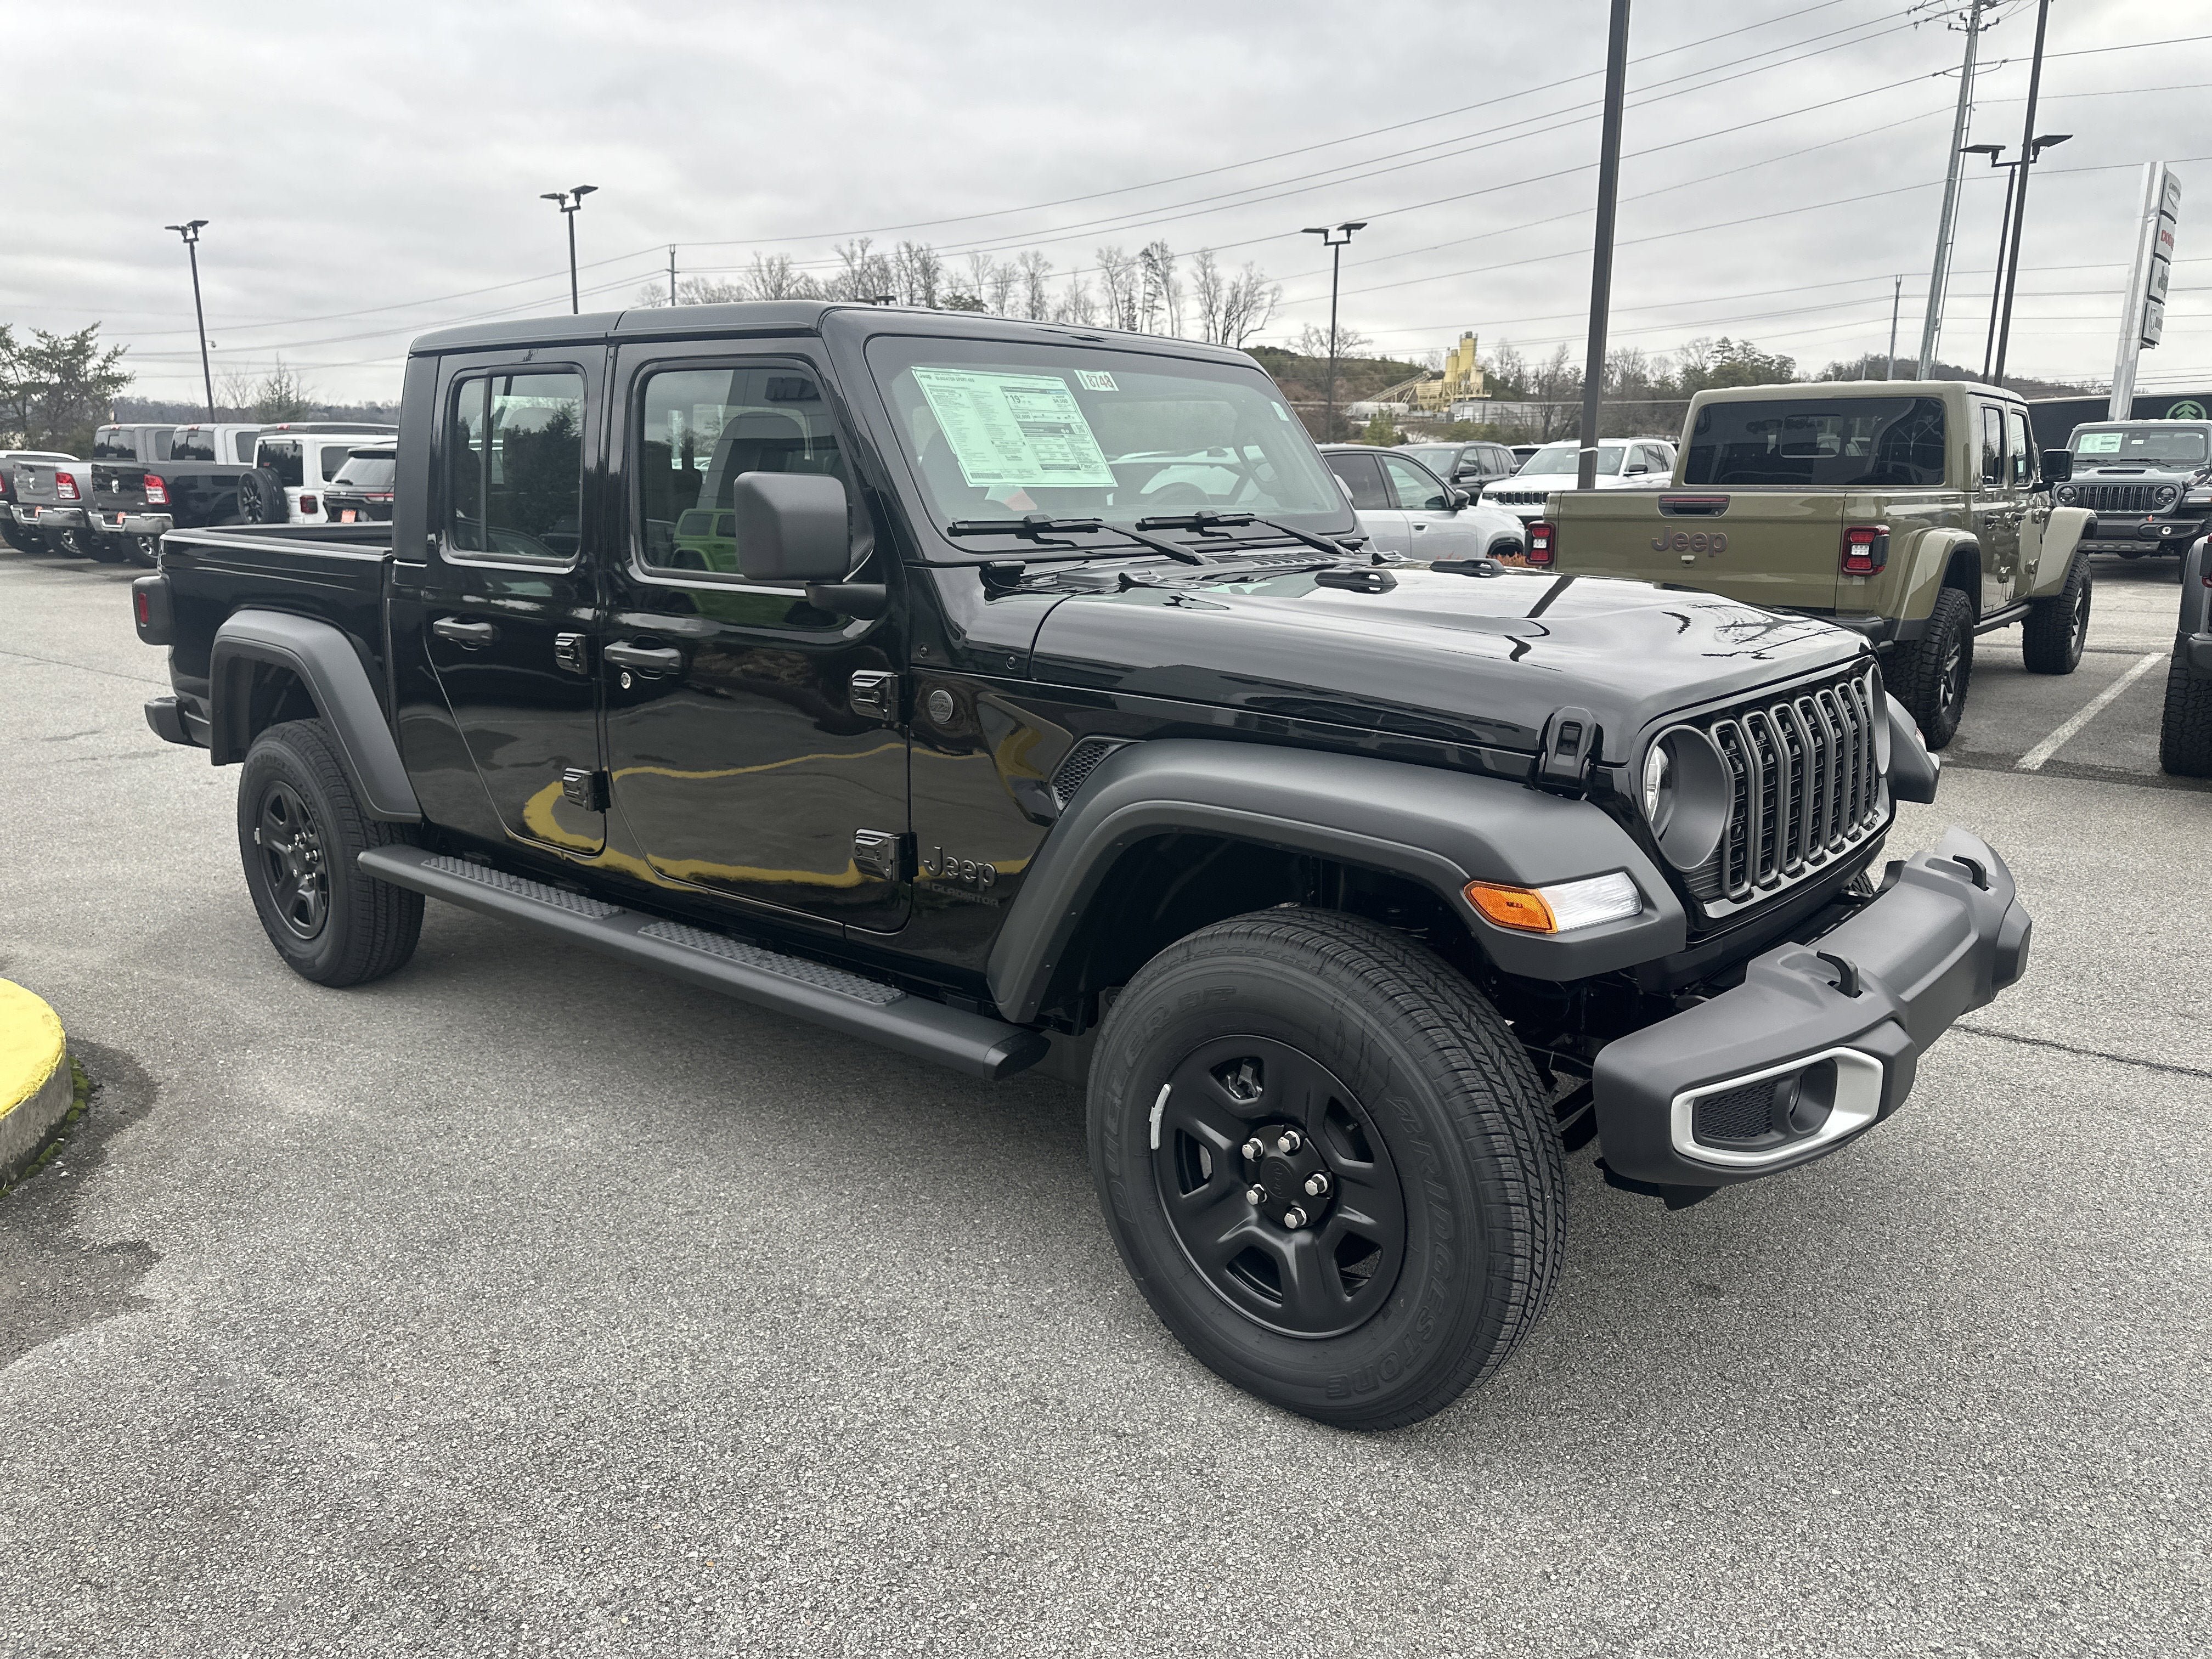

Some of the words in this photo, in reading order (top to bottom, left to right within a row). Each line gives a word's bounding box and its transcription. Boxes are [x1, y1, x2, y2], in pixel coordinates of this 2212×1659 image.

[1086, 374, 1114, 388] 8748
[1009, 394, 1021, 403] 19
[1651, 525, 1728, 557] Jeep
[923, 846, 998, 891] Jeep
